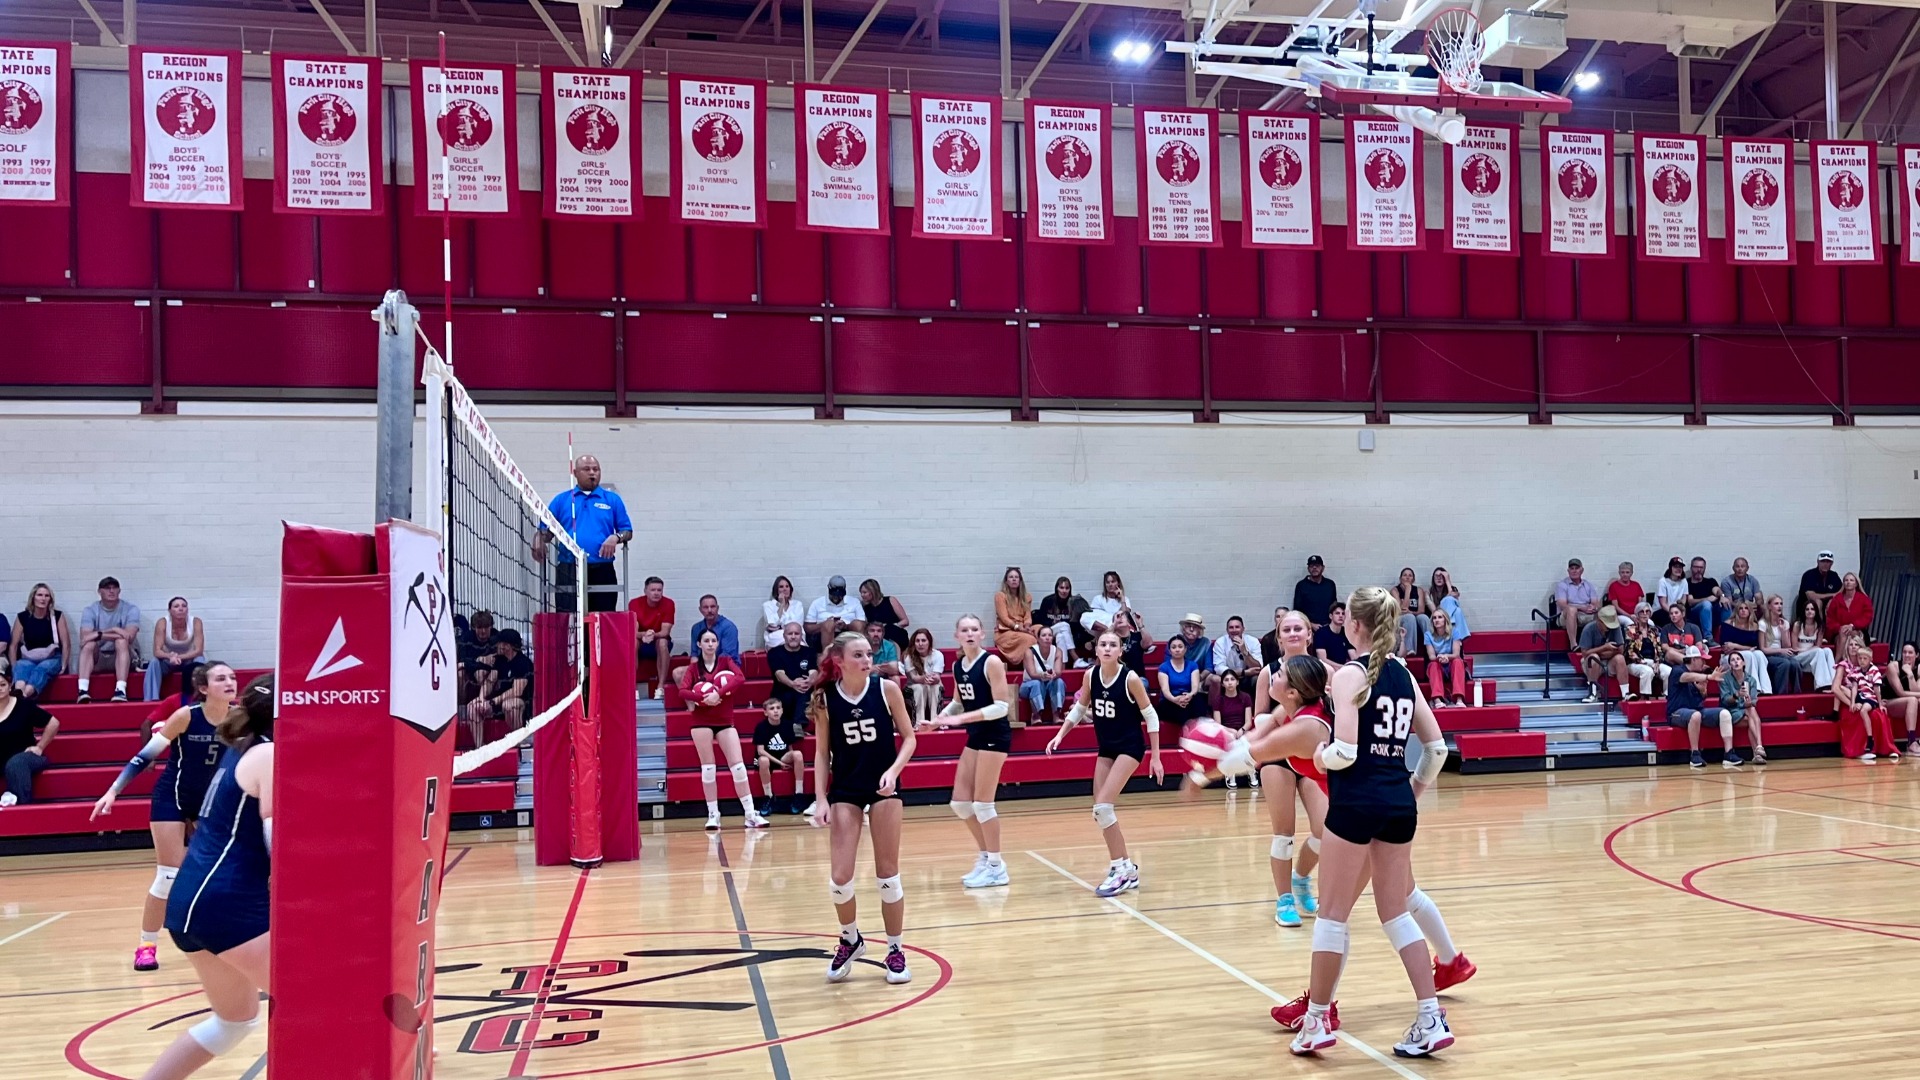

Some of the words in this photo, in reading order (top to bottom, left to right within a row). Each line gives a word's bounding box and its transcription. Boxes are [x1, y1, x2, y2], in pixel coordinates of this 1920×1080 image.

[0, 50, 34, 60] TATE
[163, 56, 207, 67] REGION
[0, 65, 51, 75] MPIONS
[306, 63, 347, 75] STATE
[148, 70, 223, 82] CHAMPIONS
[573, 76, 611, 86] STATE
[289, 77, 364, 90] CHAMPIONS
[558, 88, 626, 101] CHAMPIONS
[699, 84, 735, 95] STATE
[684, 97, 750, 109] CHAMPIONS
[822, 94, 859, 104] REGION
[809, 106, 873, 118] CHAMPIONS
[939, 102, 973, 112] STATE
[1051, 109, 1085, 119] REGION
[1161, 114, 1192, 124] STATE
[925, 114, 987, 125] CHAMPIONS
[1263, 119, 1294, 128] STATE
[1038, 121, 1098, 132] CHAMPIONS
[1148, 126, 1205, 137] CHAMPIONS
[1368, 123, 1399, 132] REGION
[1252, 130, 1307, 141] CHAMPIONS
[1466, 128, 1495, 138] STATE
[1357, 134, 1411, 144] CHAMPIONS
[1562, 134, 1592, 144] REGION
[1656, 140, 1684, 150] REGION
[1745, 145, 1772, 153] STATE
[1552, 146, 1602, 156] CHAMPIONS
[1830, 147, 1856, 156] STATE
[1646, 151, 1696, 162] CHAMPIONS
[1735, 155, 1783, 165] CHAMPIONS
[311, 161, 347, 169] SOCCER
[1821, 158, 1866, 167] CHAMPIONS
[347, 171, 366, 179] 1995
[577, 168, 610, 176] SOCCER
[560, 177, 577, 185] 1997
[699, 176, 738, 185] SWIMMING
[560, 185, 580, 193] 2004
[823, 183, 862, 191] SWIMMING
[937, 189, 978, 197] SWIMMING
[292, 197, 311, 205] 1996
[320, 198, 339, 206] 1998
[1058, 195, 1082, 203] TENNIS
[1663, 217, 1683, 225] TRACK
[958, 683, 975, 700] 59
[282, 691, 319, 705] BSN
[1095, 699, 1116, 718] 56
[1374, 696, 1414, 740] 38
[843, 718, 877, 745] 55
[205, 744, 219, 765] 5
